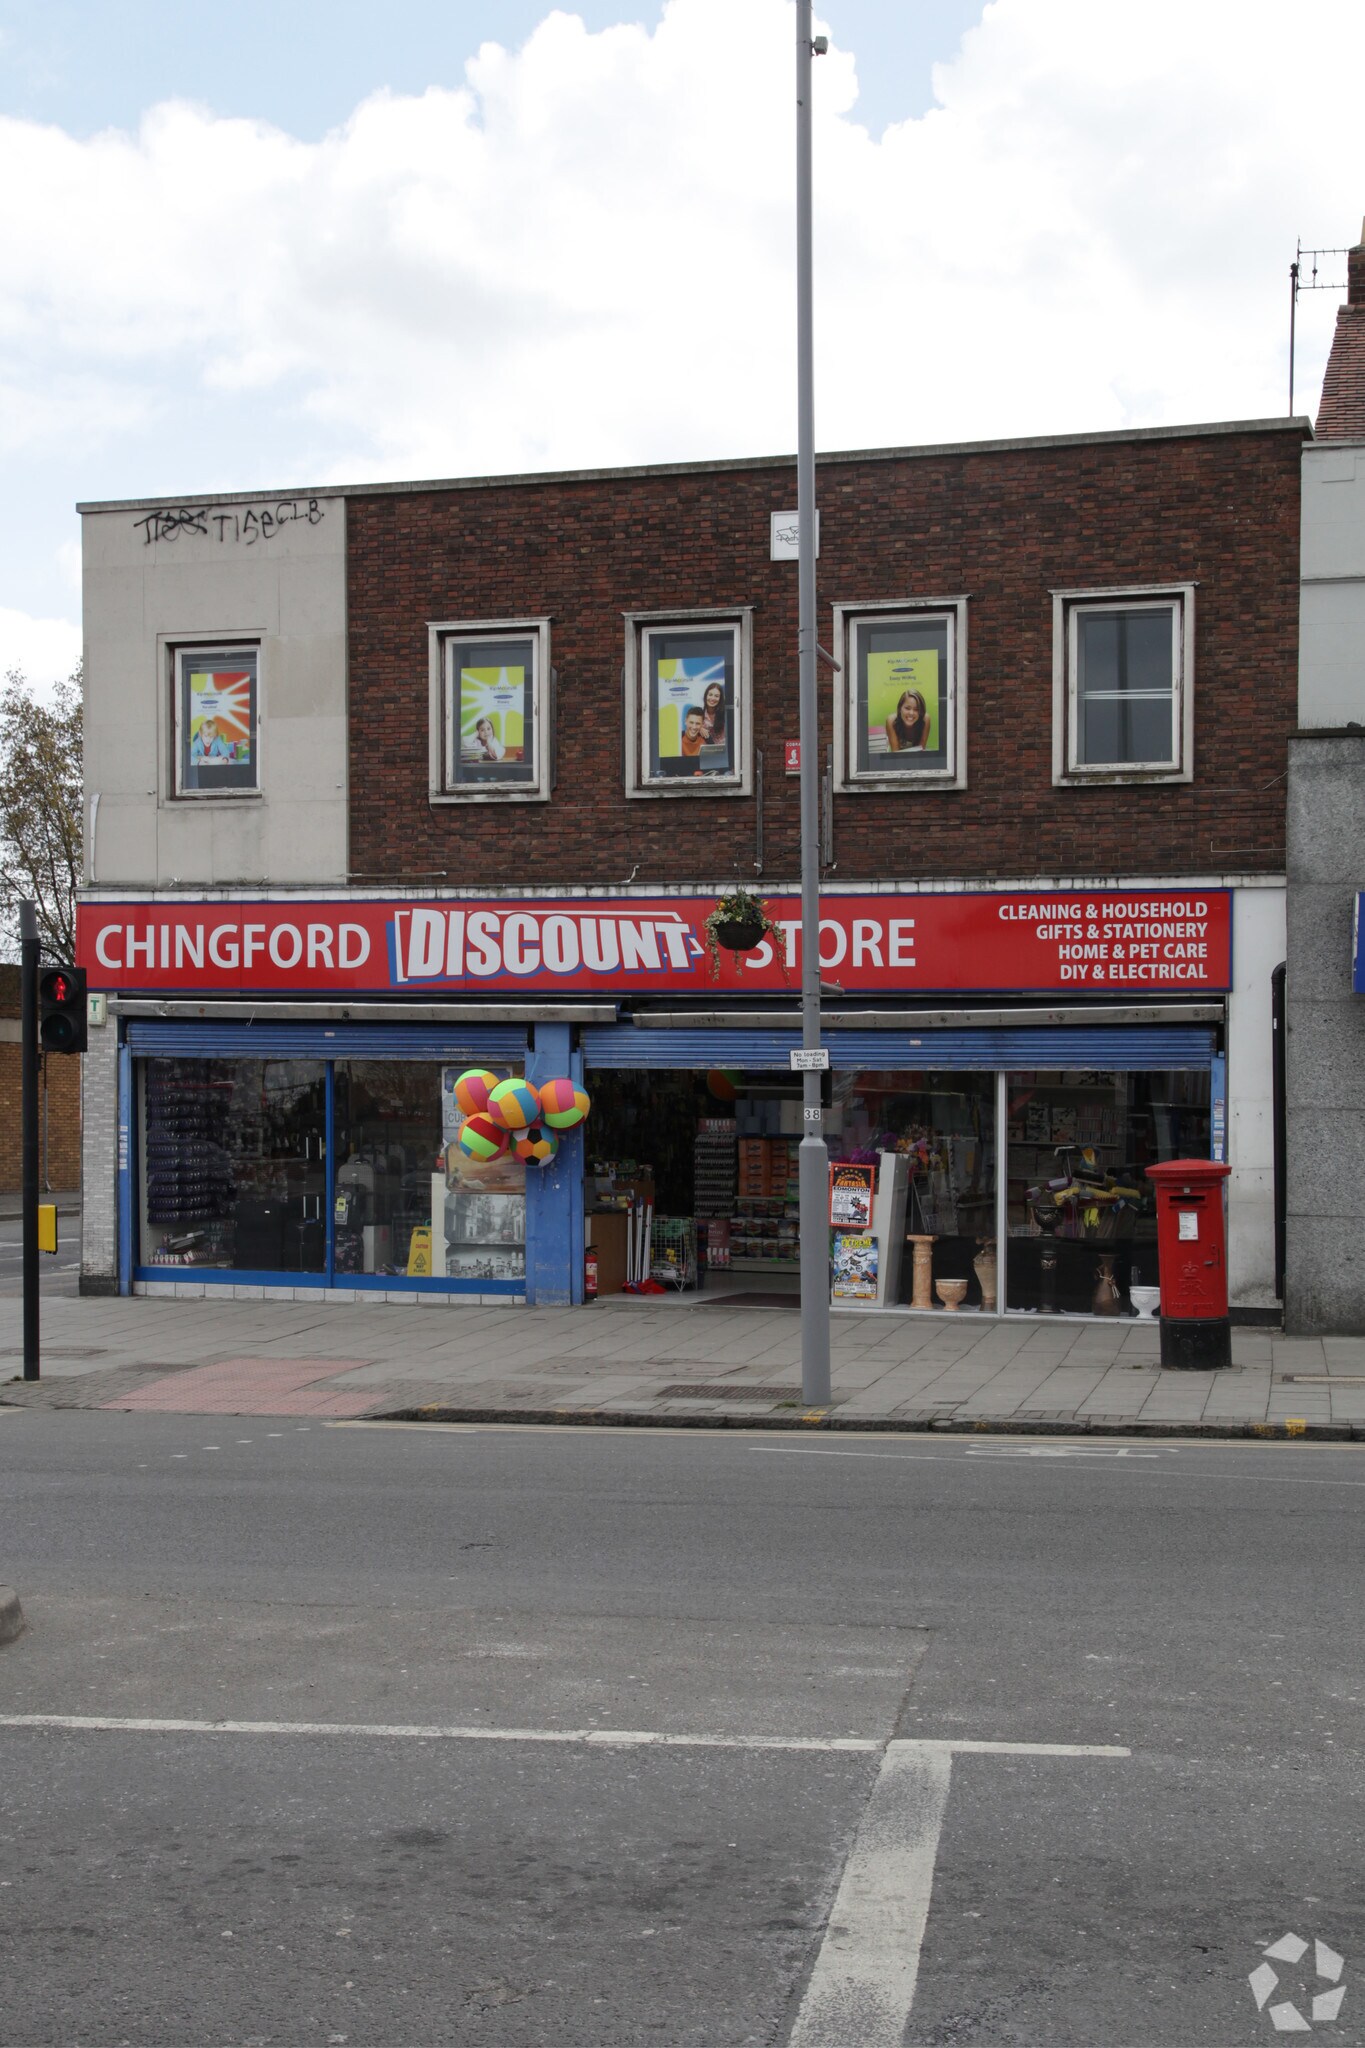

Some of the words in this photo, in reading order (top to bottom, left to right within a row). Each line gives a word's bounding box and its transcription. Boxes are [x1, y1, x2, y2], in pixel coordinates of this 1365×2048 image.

[998, 903, 1082, 920] CLEANING
[1085, 903, 1098, 919] &
[1102, 901, 1208, 919] HOUSEHOLD
[1036, 924, 1083, 940] GIFTS
[1086, 923, 1100, 939] &
[1103, 922, 1208, 939] STATIONERY
[95, 923, 371, 969] CHINGFORD
[406, 908, 691, 977] DISCOUNT
[1058, 943, 1109, 960] HOME
[1112, 943, 1126, 959] &
[1129, 943, 1161, 959] PET
[1163, 942, 1208, 959] CARE
[1060, 964, 1089, 980] DIY
[1092, 964, 1105, 980] &
[1109, 963, 1208, 979] ELECTRICAL
[804, 1109, 820, 1119] 38
[835, 1178, 868, 1188] FANTASIA
[841, 1237, 873, 1248] EXTREME
